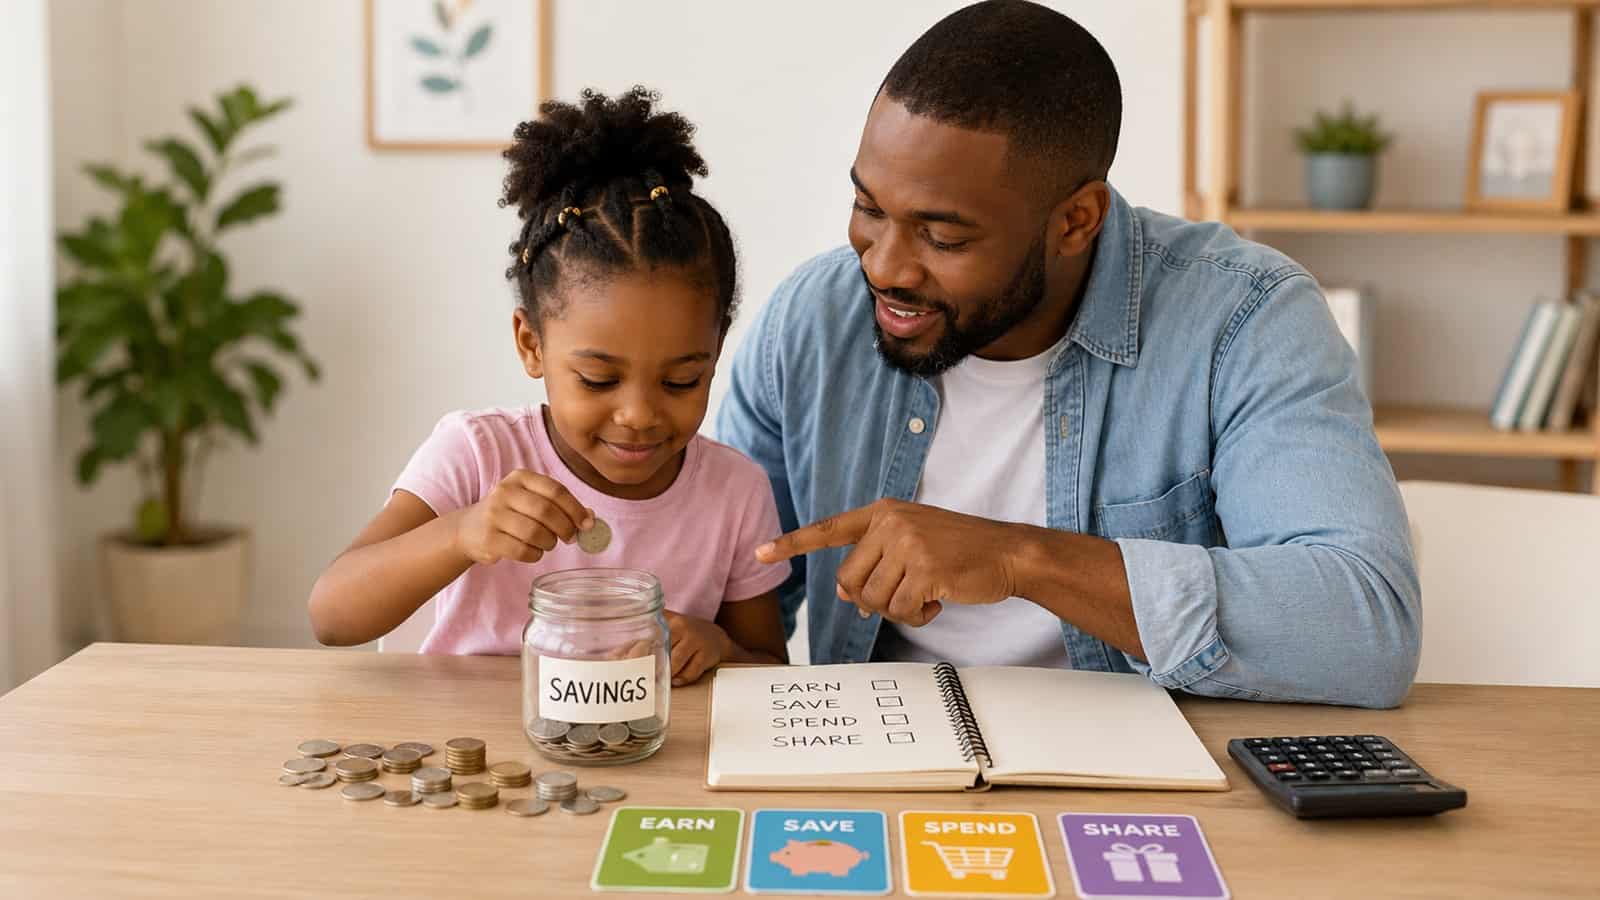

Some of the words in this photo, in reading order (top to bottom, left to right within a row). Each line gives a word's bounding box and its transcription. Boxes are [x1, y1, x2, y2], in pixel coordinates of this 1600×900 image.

[550, 677, 648, 705] SAVINGS
[770, 681, 841, 694] EARN
[771, 699, 841, 711] SAVE
[771, 716, 858, 729] SPEND
[772, 734, 864, 748] SHARE
[639, 817, 716, 831] EARN
[783, 818, 855, 833] SAVE
[924, 821, 1017, 835] SPEND
[1082, 823, 1181, 838] SHARE
